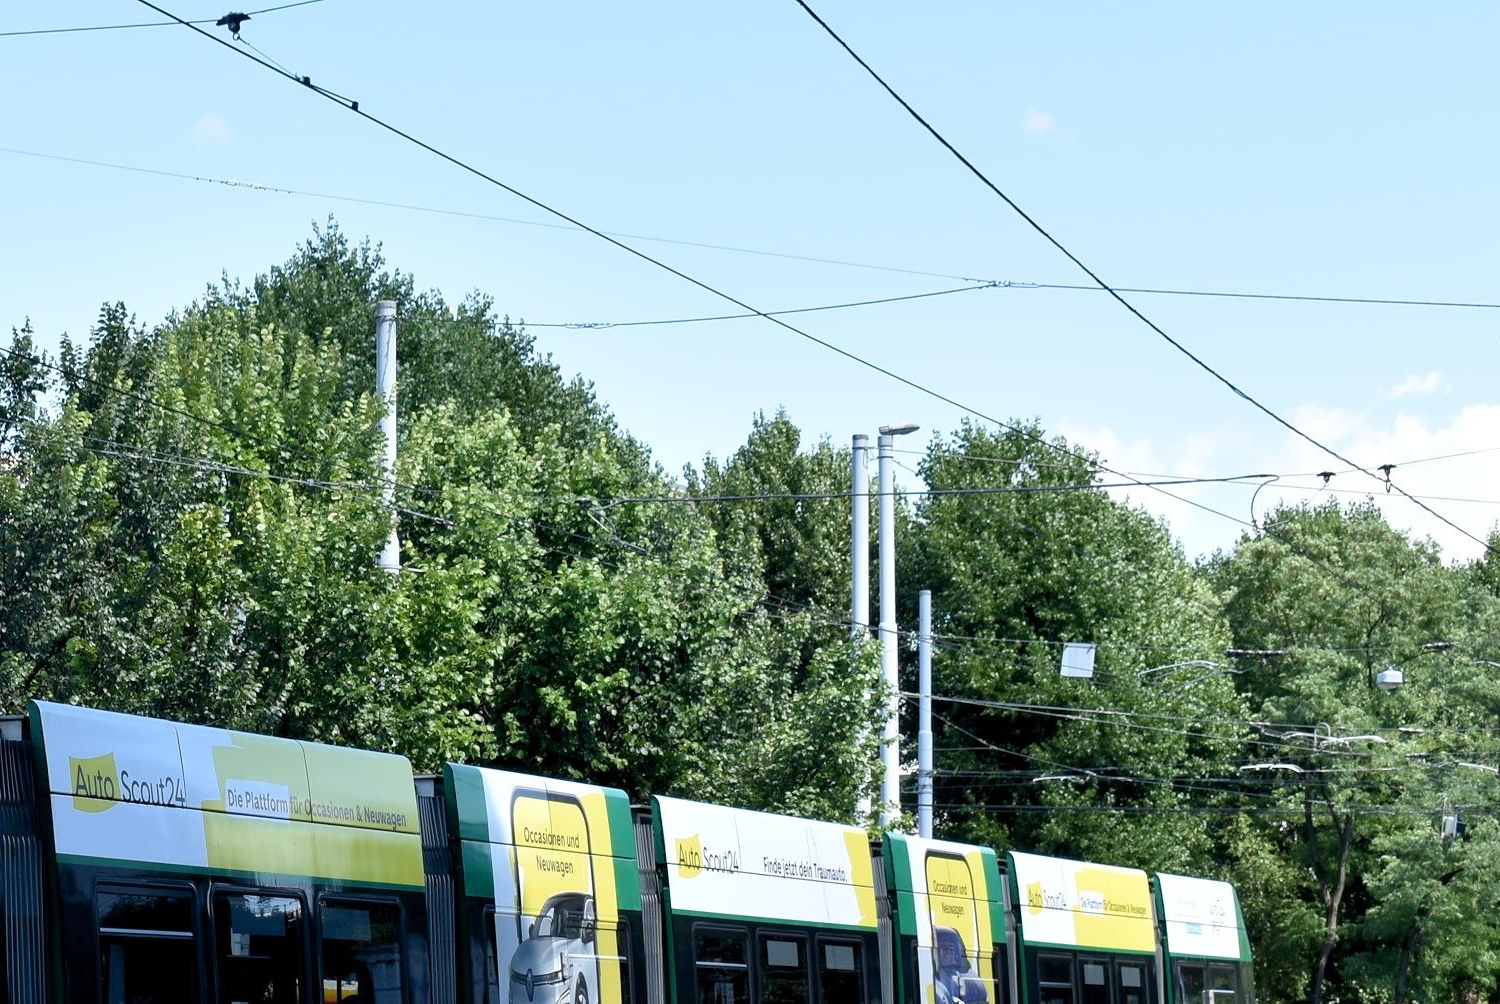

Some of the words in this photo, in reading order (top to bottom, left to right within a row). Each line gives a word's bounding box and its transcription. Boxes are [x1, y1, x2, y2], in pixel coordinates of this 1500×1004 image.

[75, 764, 115, 800] Auto
[120, 770, 186, 809] Scout24
[227, 789, 243, 808] Die
[245, 791, 288, 813] Plattform
[290, 796, 304, 815] für
[305, 798, 354, 822] Occasionen
[356, 805, 363, 822] &
[364, 807, 407, 831] Neuwagen
[523, 826, 565, 847] Occasionen
[567, 833, 579, 848] und
[536, 854, 573, 877] Neuwagen
[679, 843, 700, 870] Auto
[703, 847, 739, 874] Scout24
[763, 857, 781, 873] Finde
[782, 859, 798, 877] jetzt
[799, 863, 812, 878] dein
